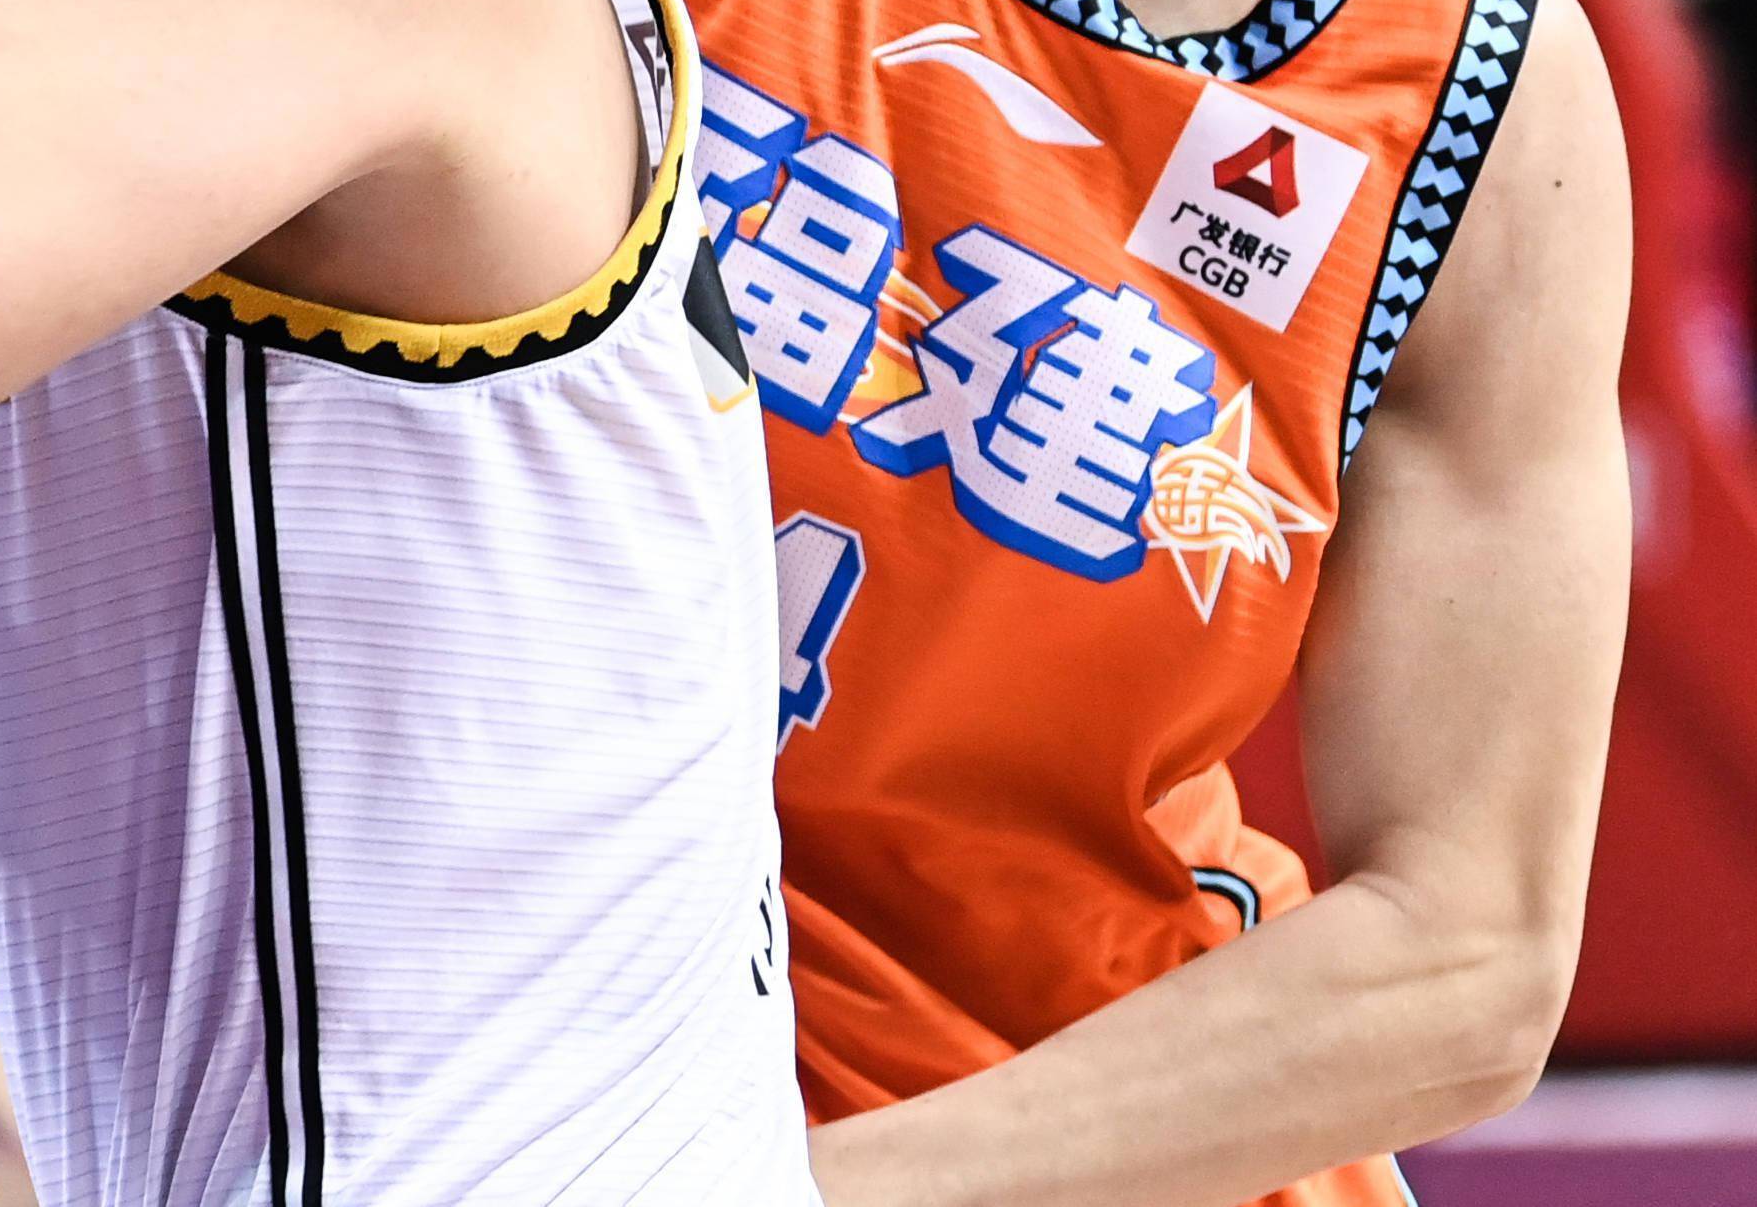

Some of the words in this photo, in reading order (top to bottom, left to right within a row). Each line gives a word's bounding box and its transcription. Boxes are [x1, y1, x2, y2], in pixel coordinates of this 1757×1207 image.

[1170, 200, 1292, 277] 广发银行
[1178, 245, 1250, 298] CGB
[700, 56, 1220, 582] 福建
